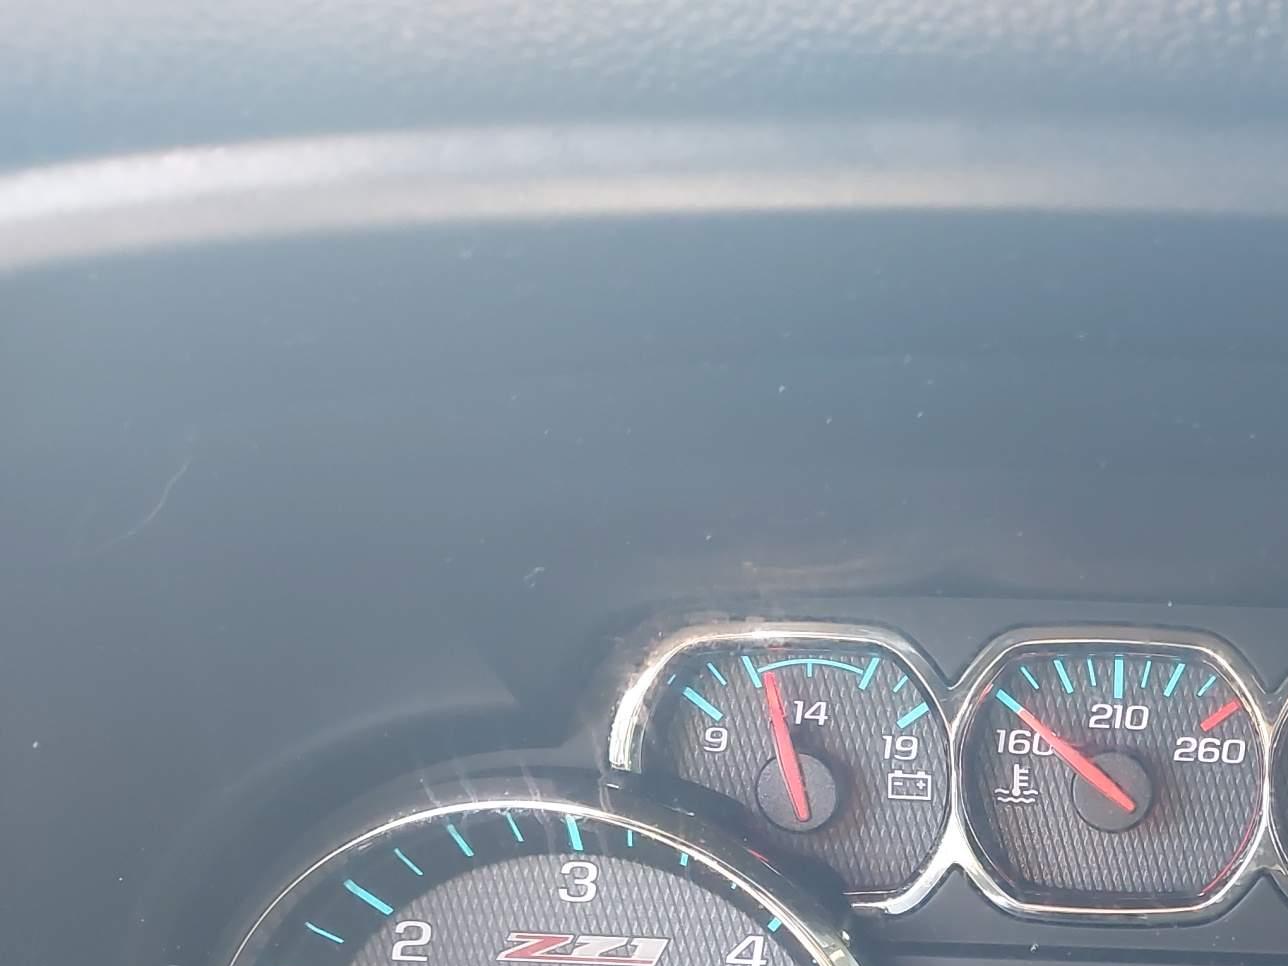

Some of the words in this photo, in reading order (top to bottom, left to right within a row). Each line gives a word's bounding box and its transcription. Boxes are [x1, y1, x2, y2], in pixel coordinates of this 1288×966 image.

[794, 702, 828, 725] 14
[1089, 704, 1148, 730] 210
[703, 728, 727, 753] 9
[882, 737, 918, 760] 19
[1174, 739, 1245, 764] 260
[559, 862, 598, 901] 3
[392, 922, 432, 961] 2
